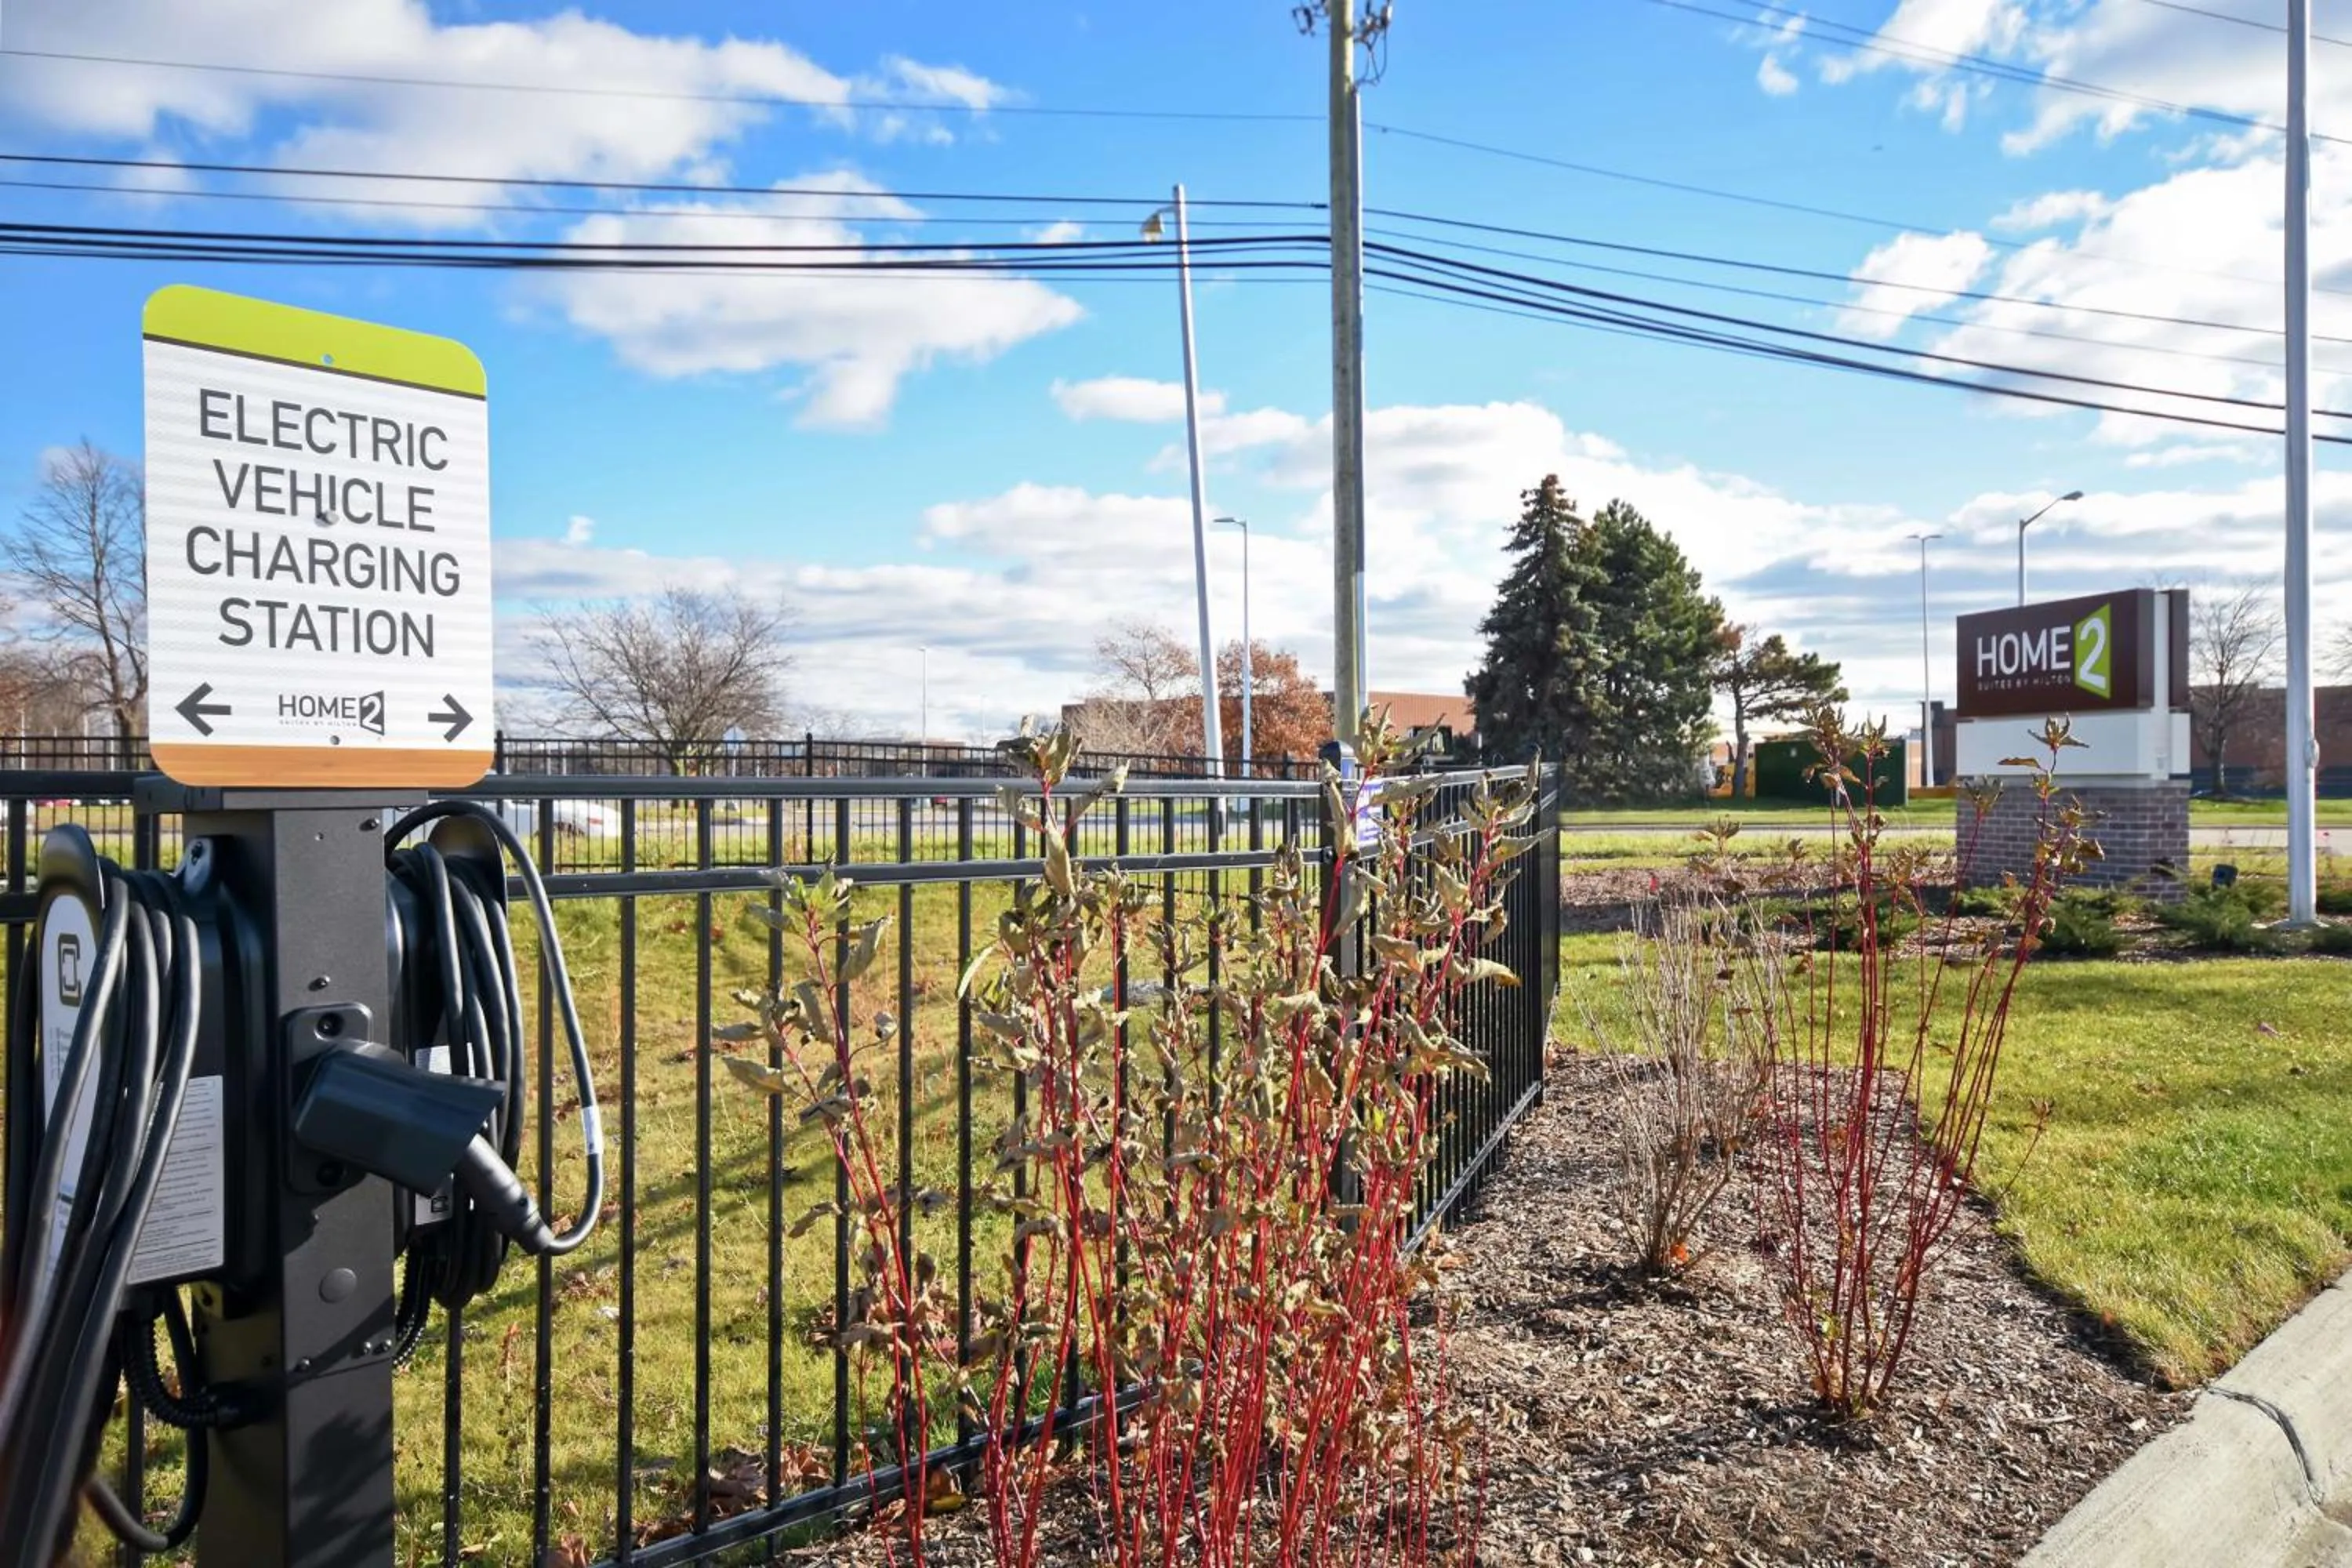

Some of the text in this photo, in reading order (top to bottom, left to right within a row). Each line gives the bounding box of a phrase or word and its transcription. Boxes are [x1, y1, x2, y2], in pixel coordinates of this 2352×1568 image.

[200, 388, 448, 471] ELECTRIC
[212, 459, 435, 532] VEHICLE
[186, 525, 460, 597] CHARGING
[219, 597, 434, 658] STATION
